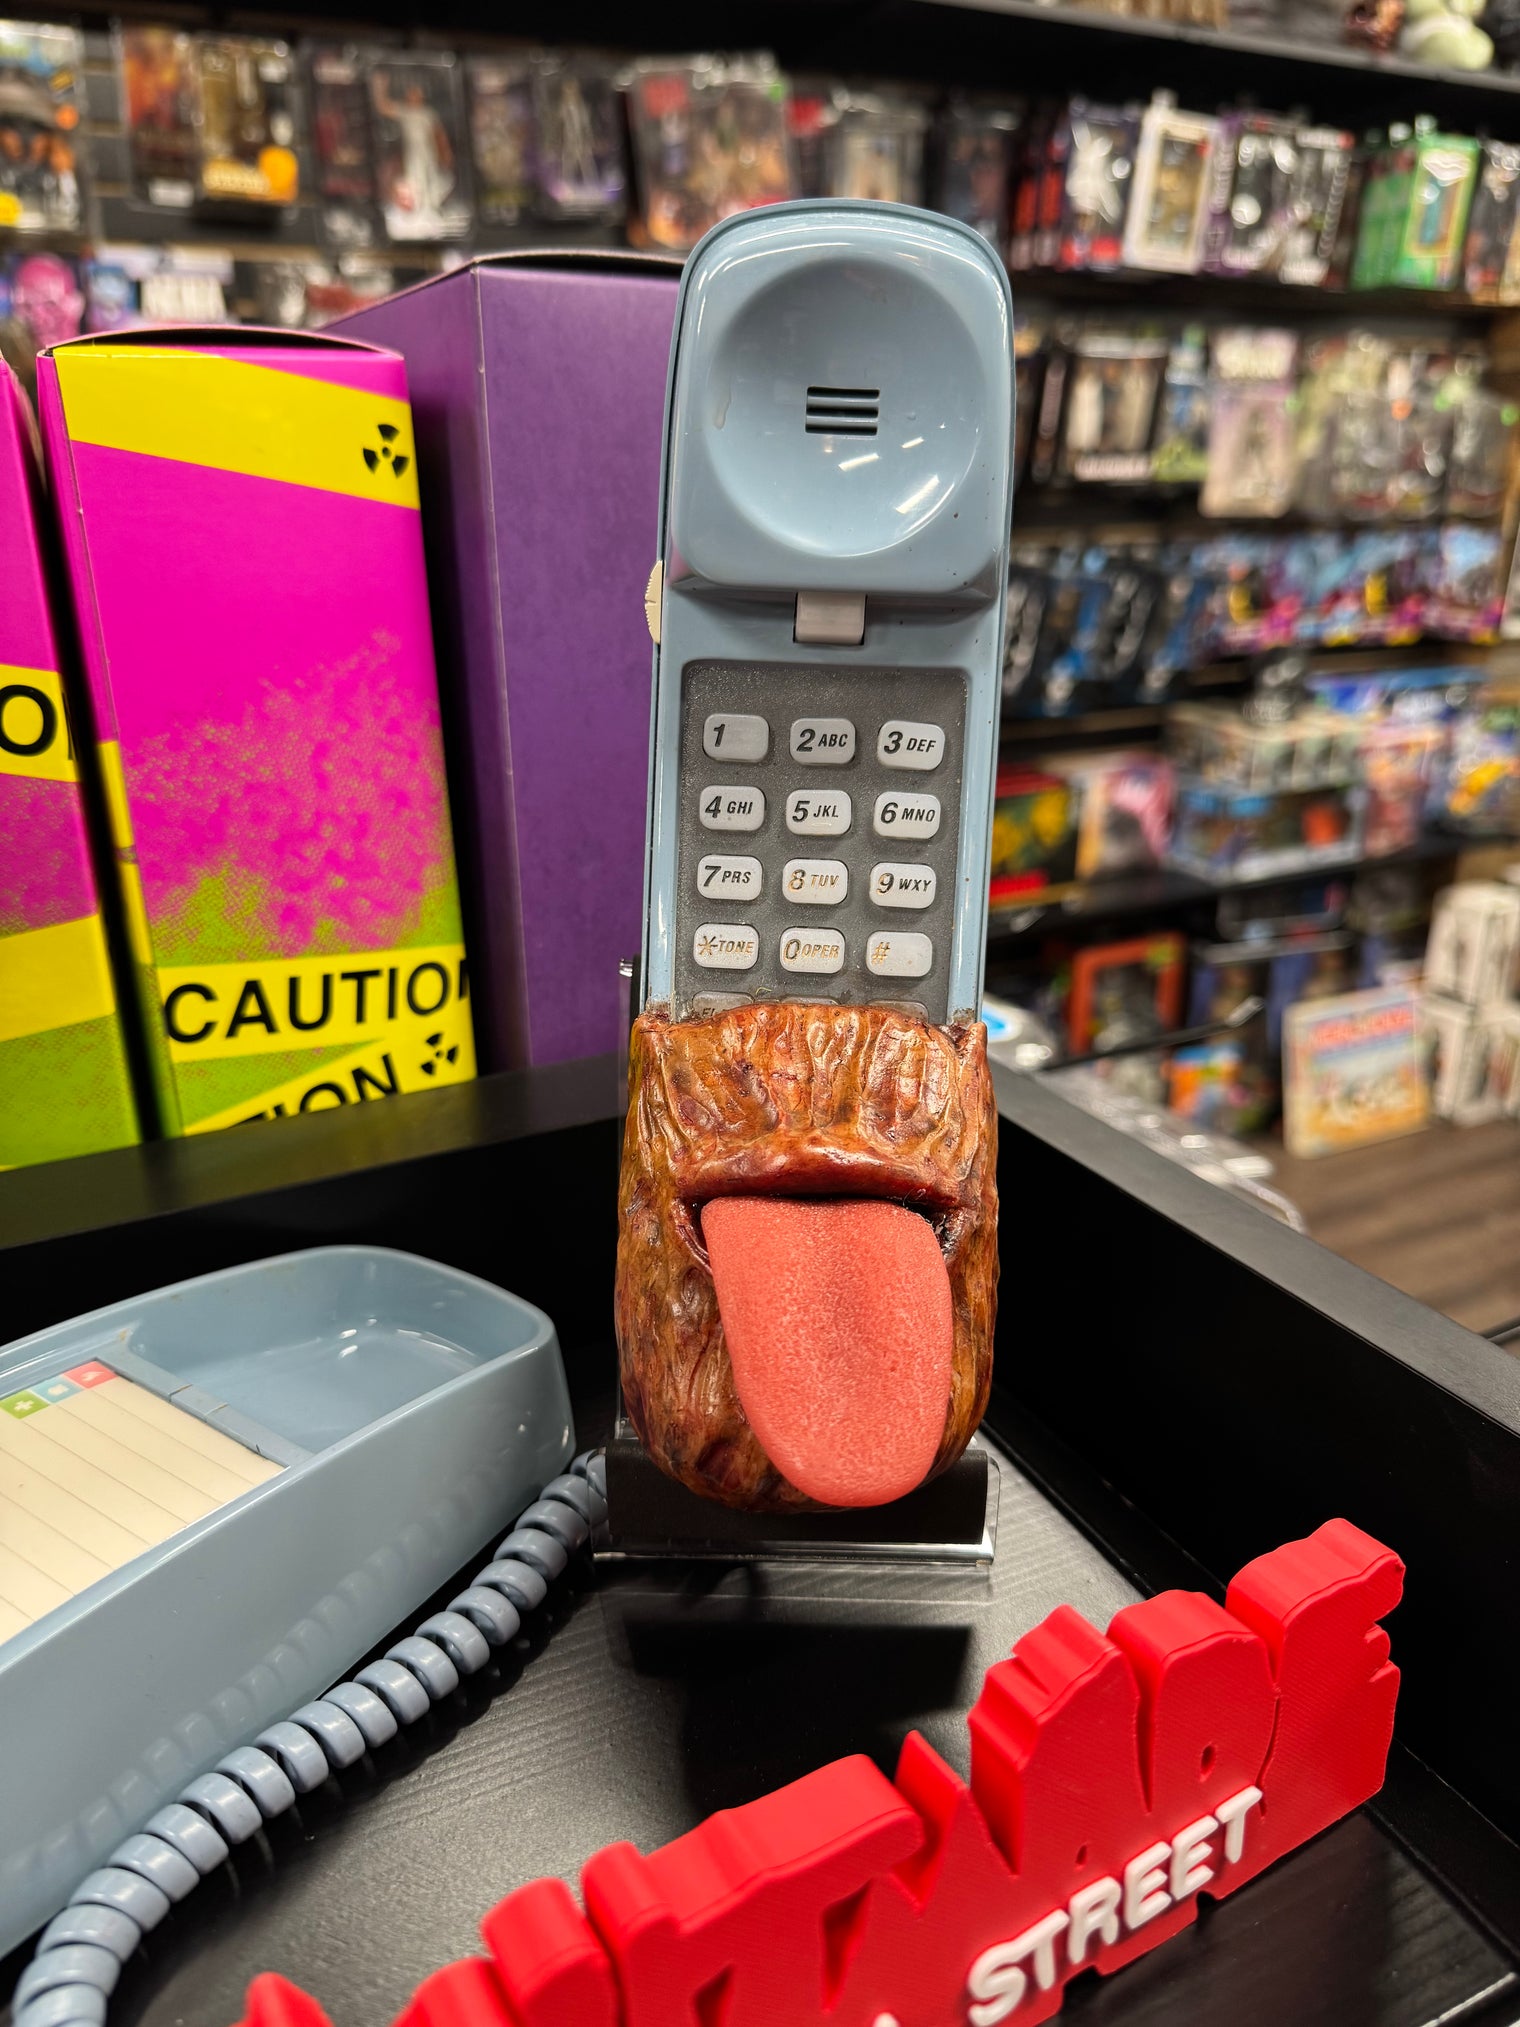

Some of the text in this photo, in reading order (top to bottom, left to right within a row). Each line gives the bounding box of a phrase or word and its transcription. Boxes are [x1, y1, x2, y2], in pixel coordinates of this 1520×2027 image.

[713, 724, 726, 747] 1
[796, 728, 848, 752] 2 ABC
[883, 731, 937, 754] 3 DEF
[705, 796, 753, 818] 4 GHI
[792, 801, 840, 823] 5 JKL
[881, 802, 936, 824] 6 MNO
[703, 865, 751, 887] 7 PRS
[788, 869, 840, 890] 8 TUV
[876, 872, 932, 894] 9 WXY
[784, 938, 840, 961] 0 OPER
[164, 958, 468, 1044] CAUTIO
[969, 1785, 1263, 2027] STREET
